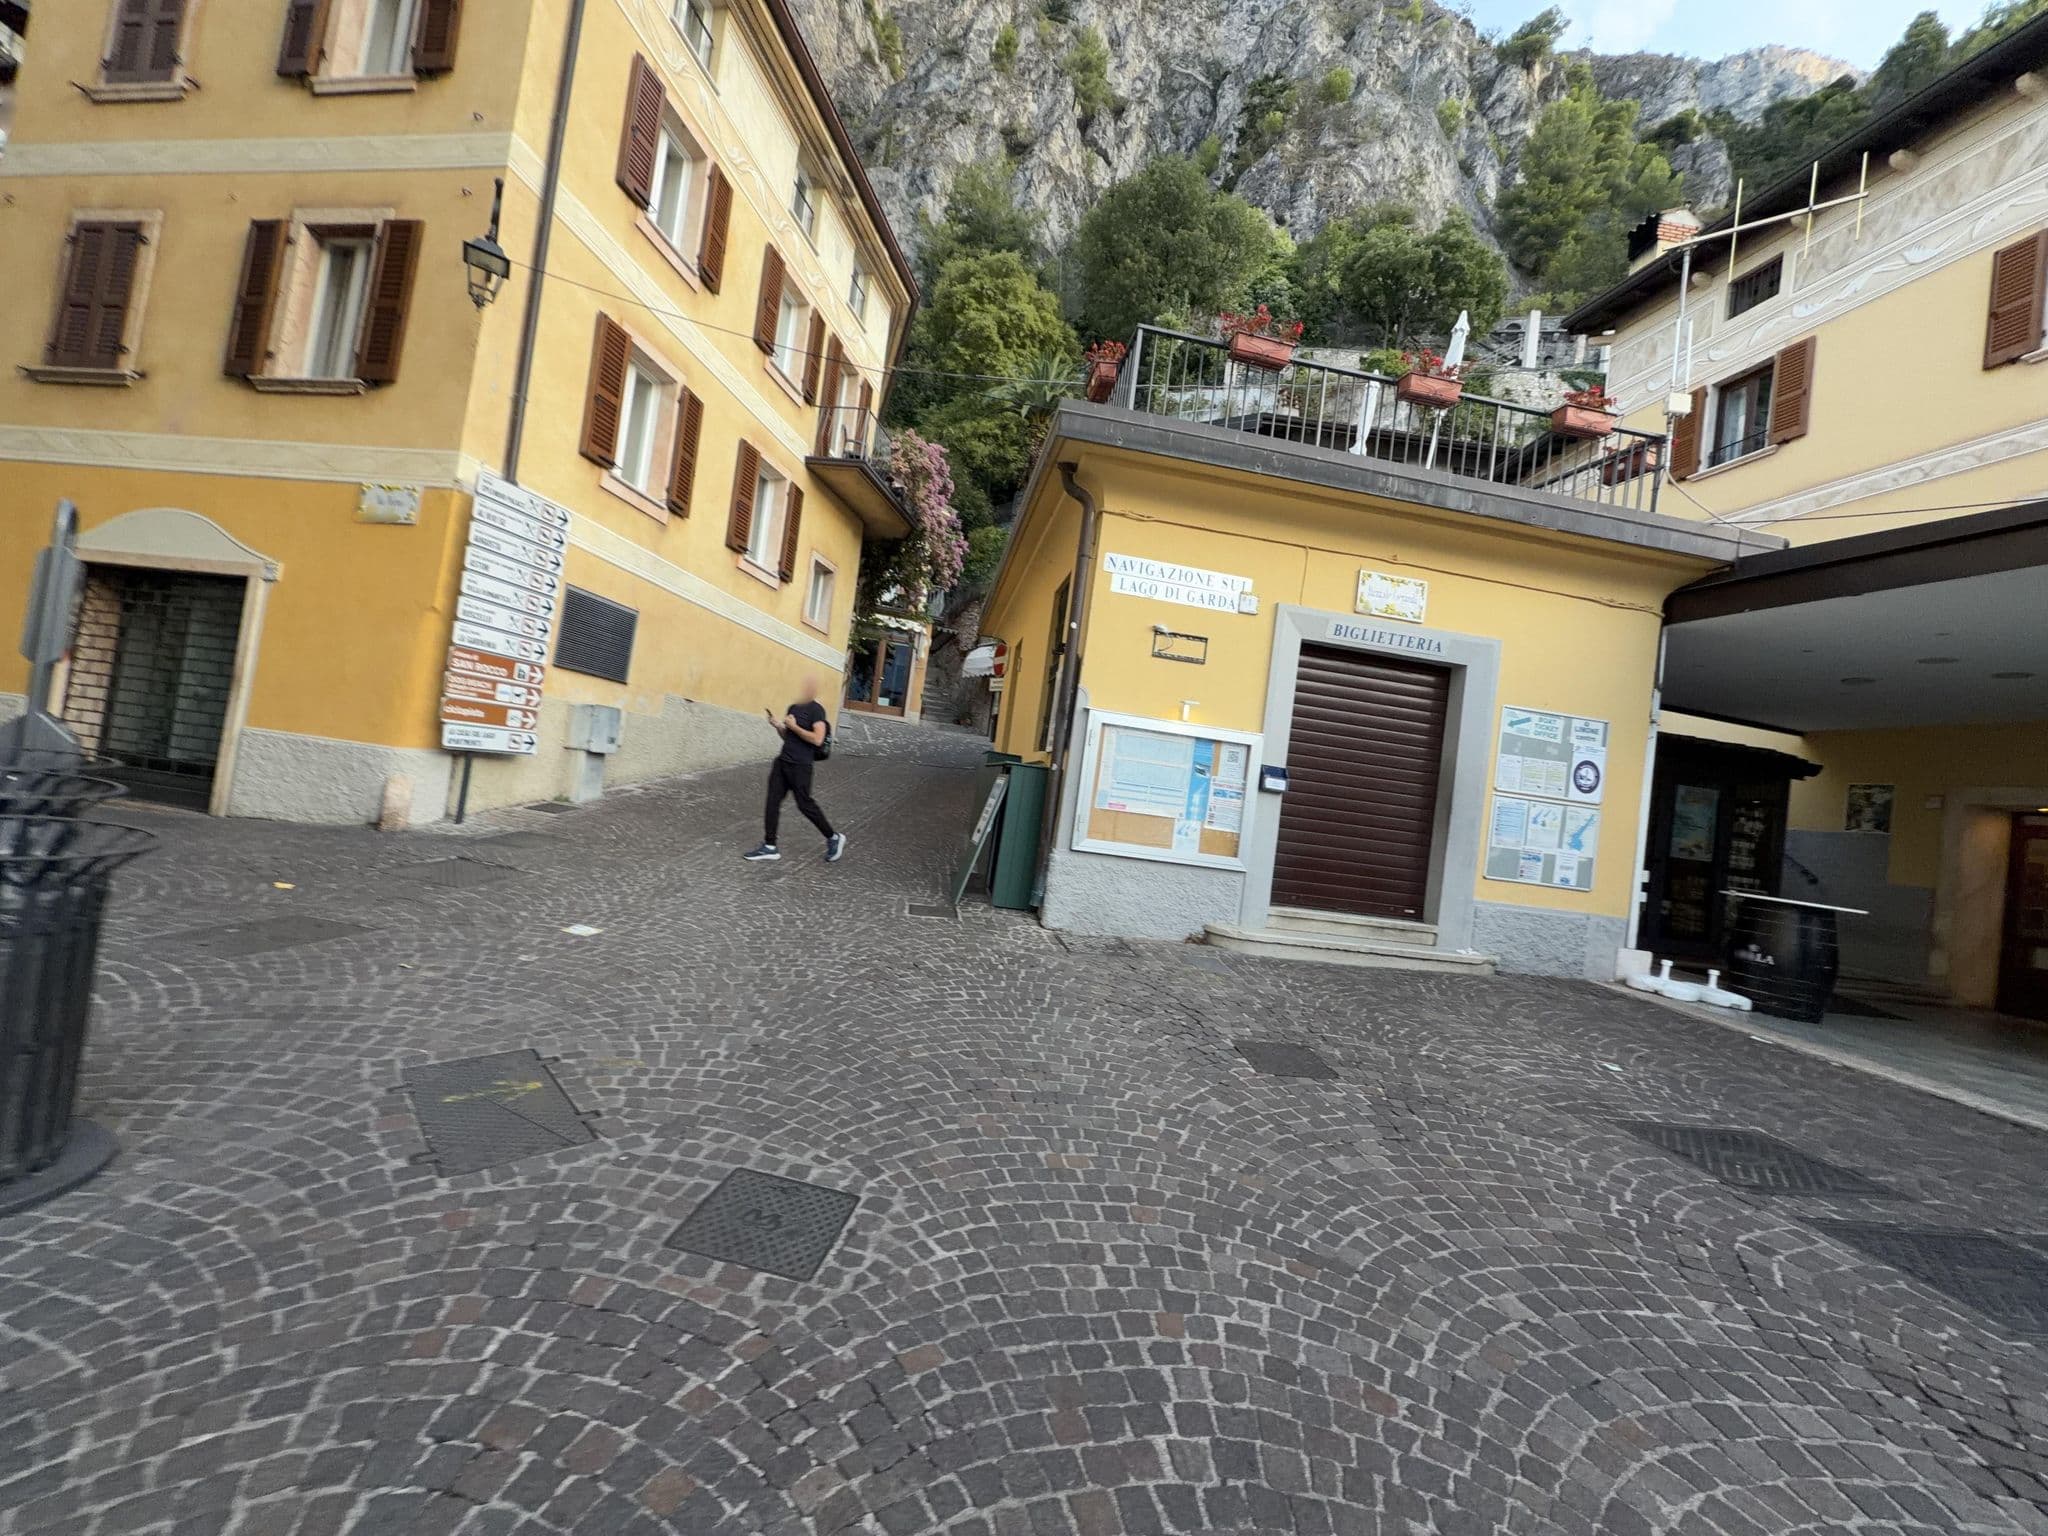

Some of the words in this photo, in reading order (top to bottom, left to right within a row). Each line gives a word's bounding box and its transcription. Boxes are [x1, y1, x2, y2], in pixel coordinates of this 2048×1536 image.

[1107, 556, 1214, 587] NAVIGAZIONE
[1119, 577, 1158, 596] LAGO
[1165, 585, 1181, 600] DI
[1187, 589, 1236, 610] GARDA
[1334, 624, 1442, 652] BIGLIETTERIA
[452, 658, 474, 670] SAN
[1538, 716, 1558, 725] BOAT
[1535, 722, 1559, 732] TICKET
[1535, 730, 1559, 740] OFFICE
